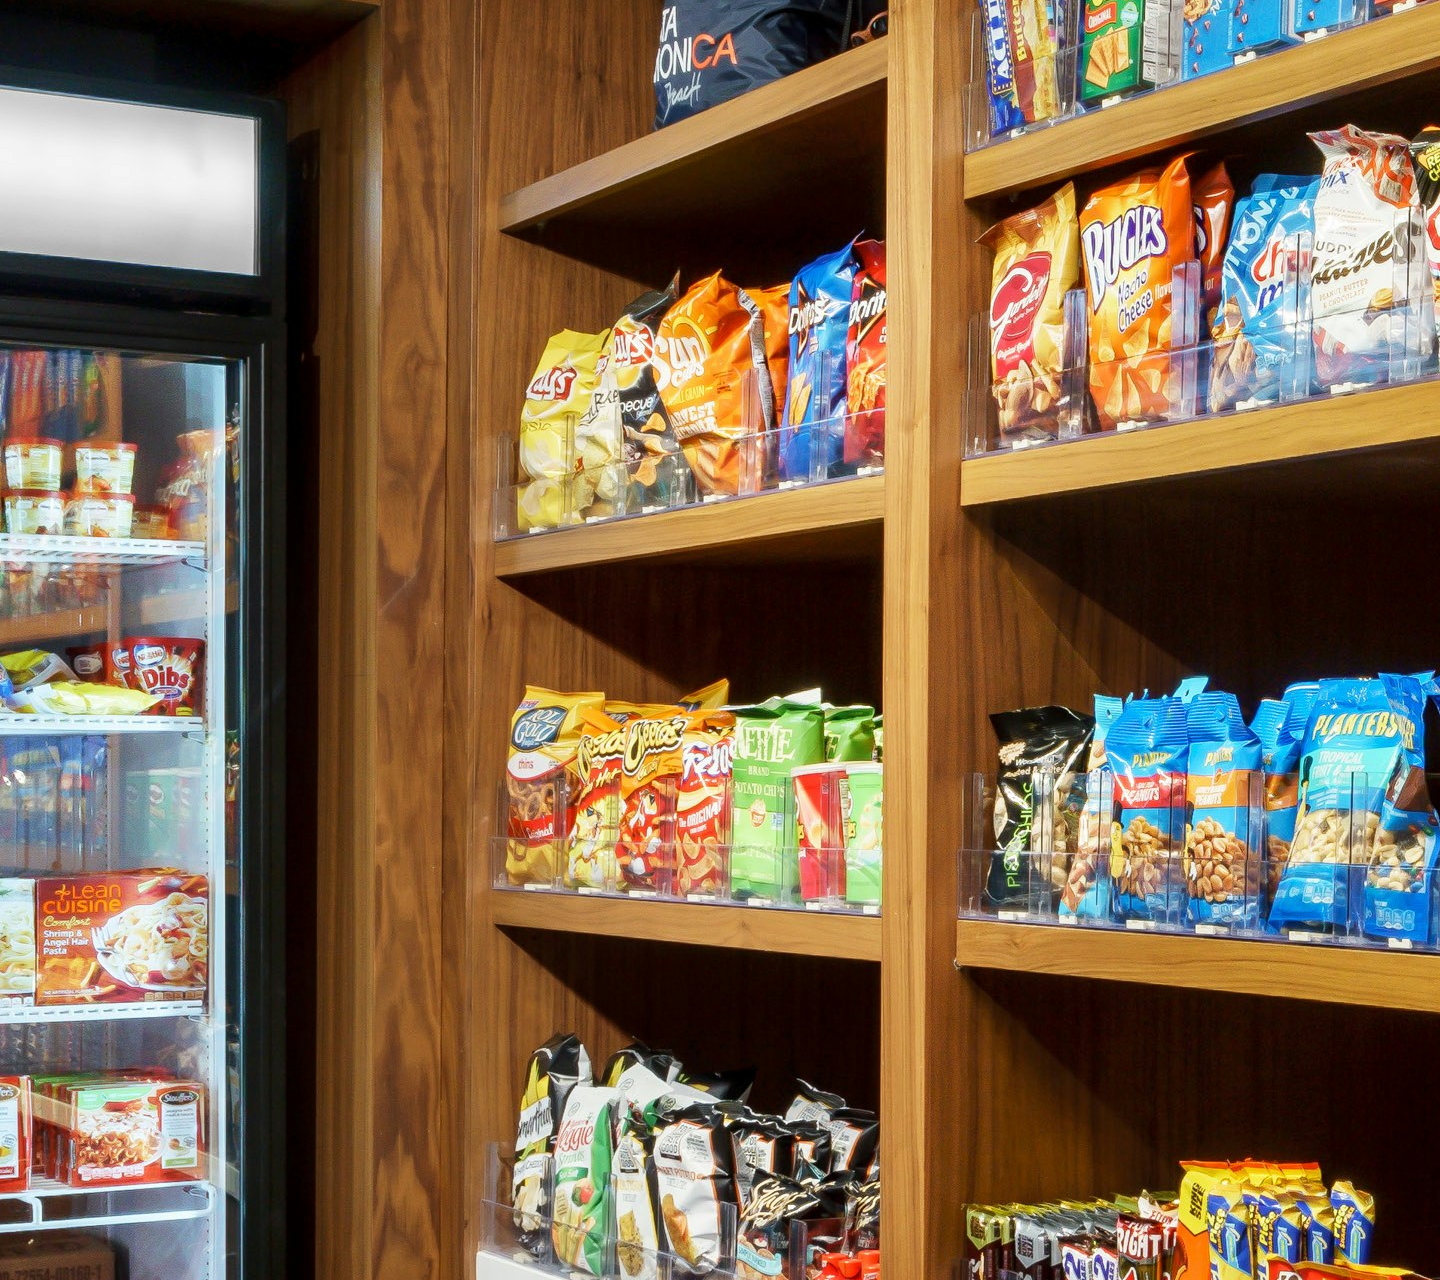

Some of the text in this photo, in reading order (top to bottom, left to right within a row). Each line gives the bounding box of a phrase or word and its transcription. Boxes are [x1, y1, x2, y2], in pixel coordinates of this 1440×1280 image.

[1082, 207, 1167, 311] BUGLES
[1117, 270, 1147, 305] Nacho
[789, 297, 824, 336] Doritos
[142, 667, 189, 689] Dibs
[1312, 712, 1398, 740] PLANTERS
[748, 766, 769, 776] BRAND
[44, 916, 91, 928] Comfort
[44, 930, 75, 939] Shrimp
[44, 938, 88, 947] Angel Hair
[44, 947, 67, 955] Pasta
